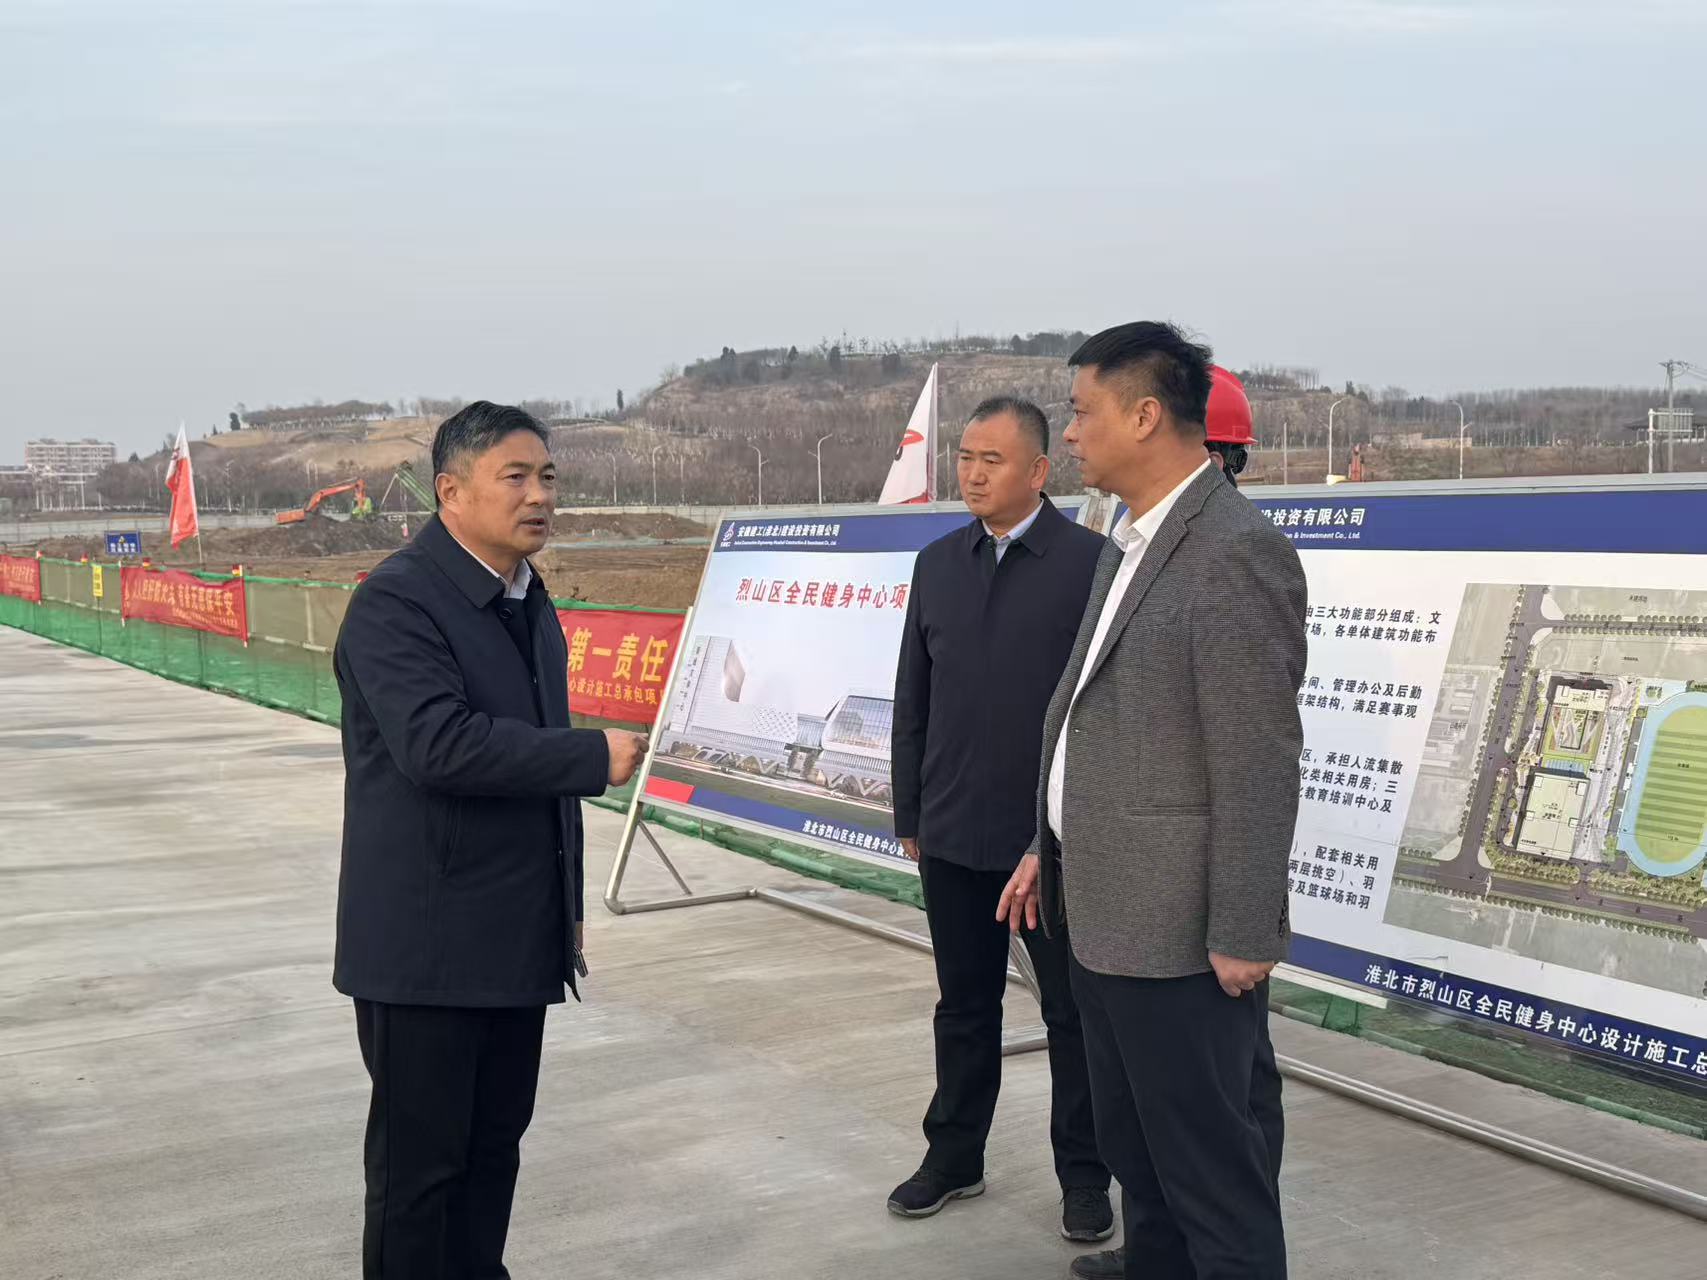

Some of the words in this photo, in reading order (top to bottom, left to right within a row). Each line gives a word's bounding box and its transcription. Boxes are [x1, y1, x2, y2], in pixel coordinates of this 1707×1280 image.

[736, 578, 909, 609] 烈山区全民健身中心项
[562, 626, 668, 682] 第一责任
[1300, 785, 1393, 813] 教育培训中心及
[802, 819, 910, 859] 淮北市烈山区全民健身中心设
[1364, 963, 1707, 1076] 淮北市烈山区全民健身中心设计施工总
